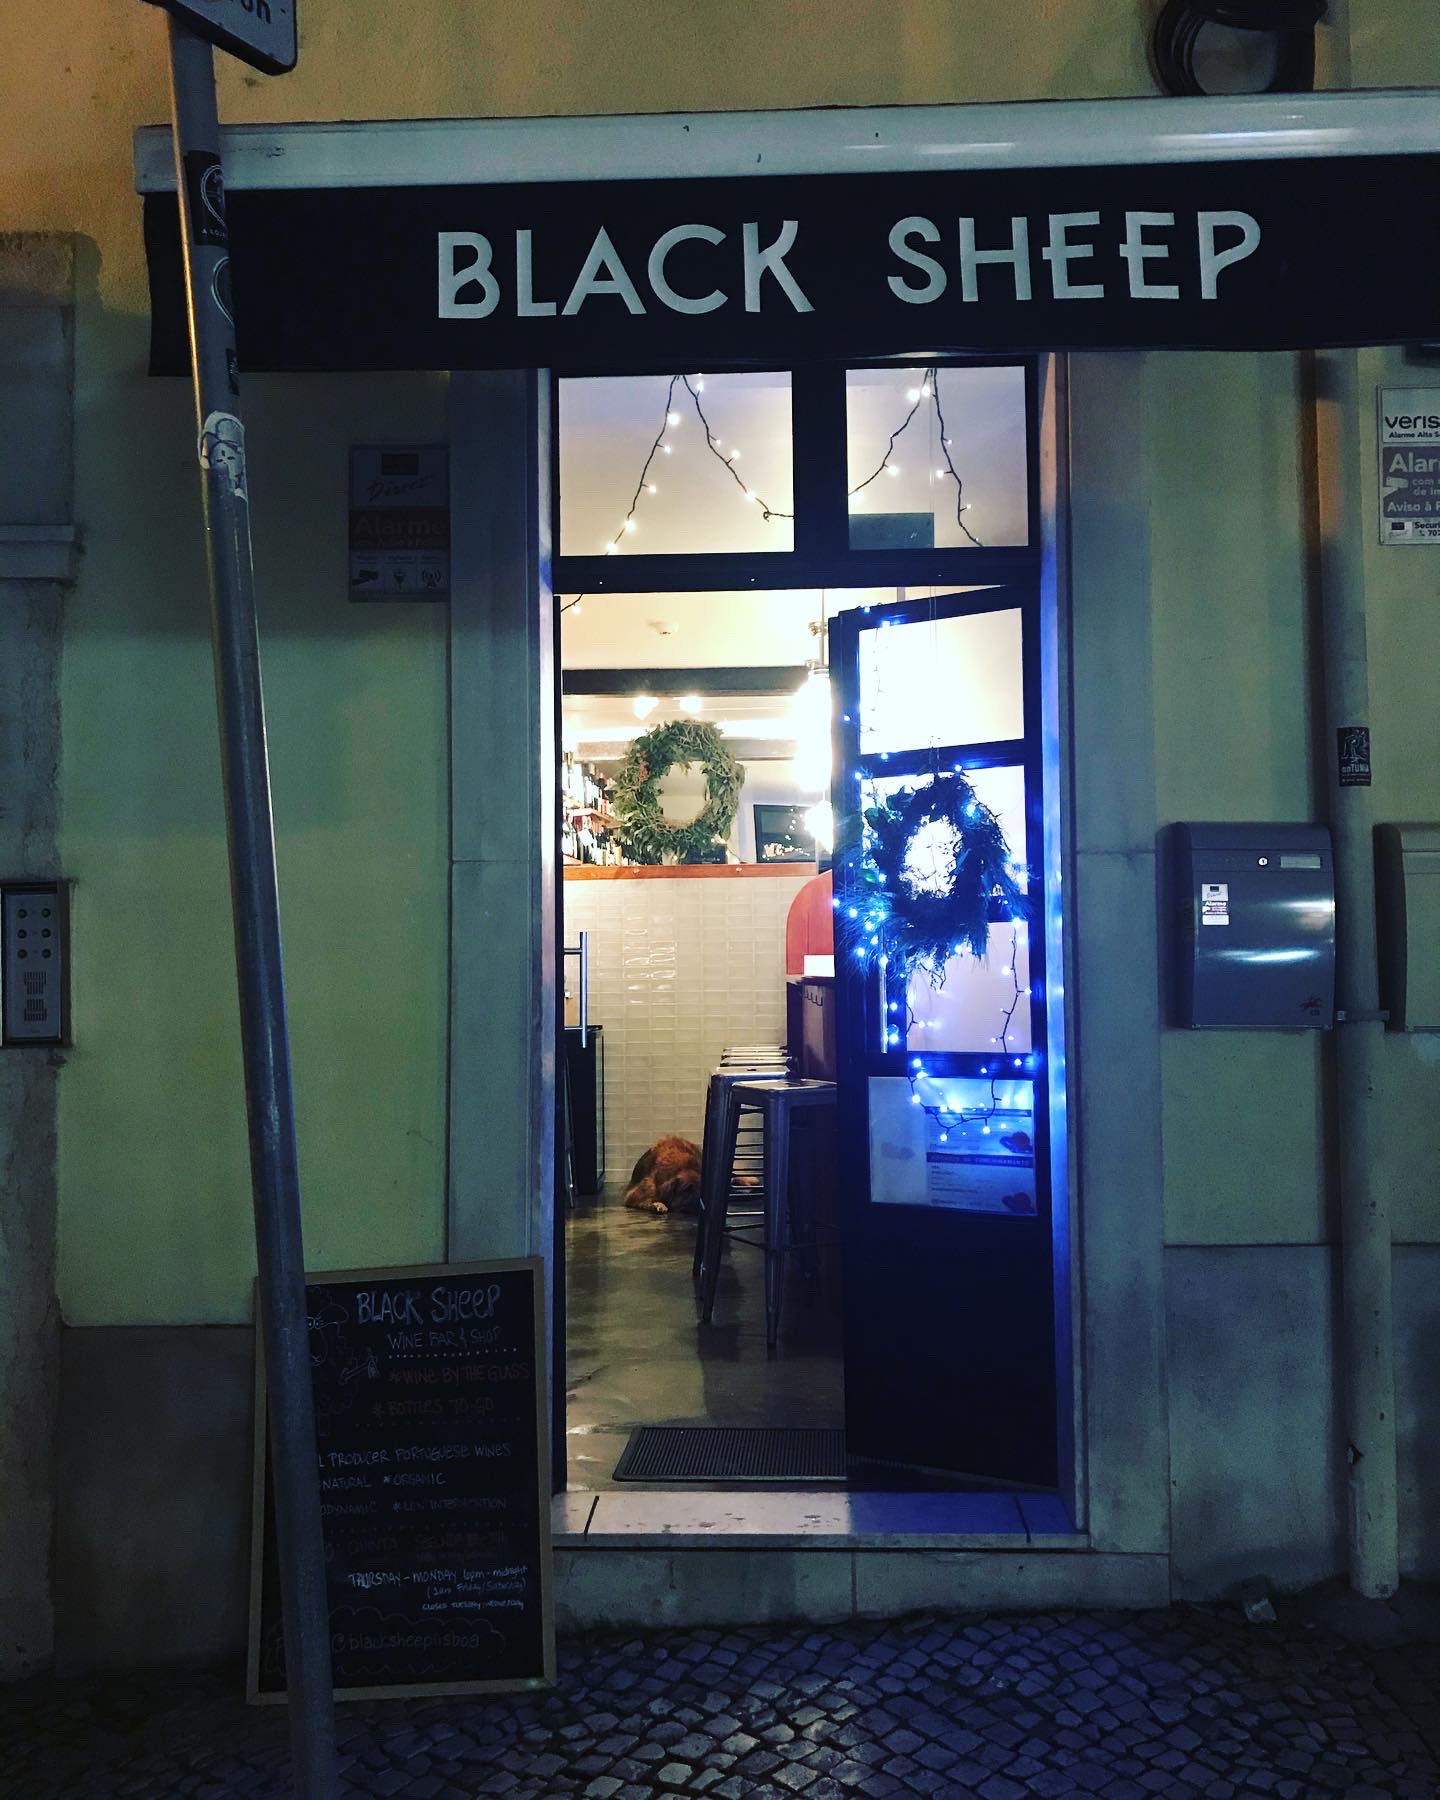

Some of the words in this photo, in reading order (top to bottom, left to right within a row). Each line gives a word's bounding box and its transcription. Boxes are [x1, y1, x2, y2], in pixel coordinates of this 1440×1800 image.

[438, 220, 815, 319] BLACK
[887, 211, 1261, 304] SHEEP
[1389, 452, 1440, 473] Alar
[1387, 501, 1421, 512] Aviso
[356, 1291, 424, 1325] BLACK
[387, 1332, 425, 1349] WINE
[429, 1330, 458, 1347] BAR
[470, 1326, 501, 1344] SHOP
[320, 1475, 374, 1490] NATURAL
[412, 1568, 457, 1584] MONDAY
